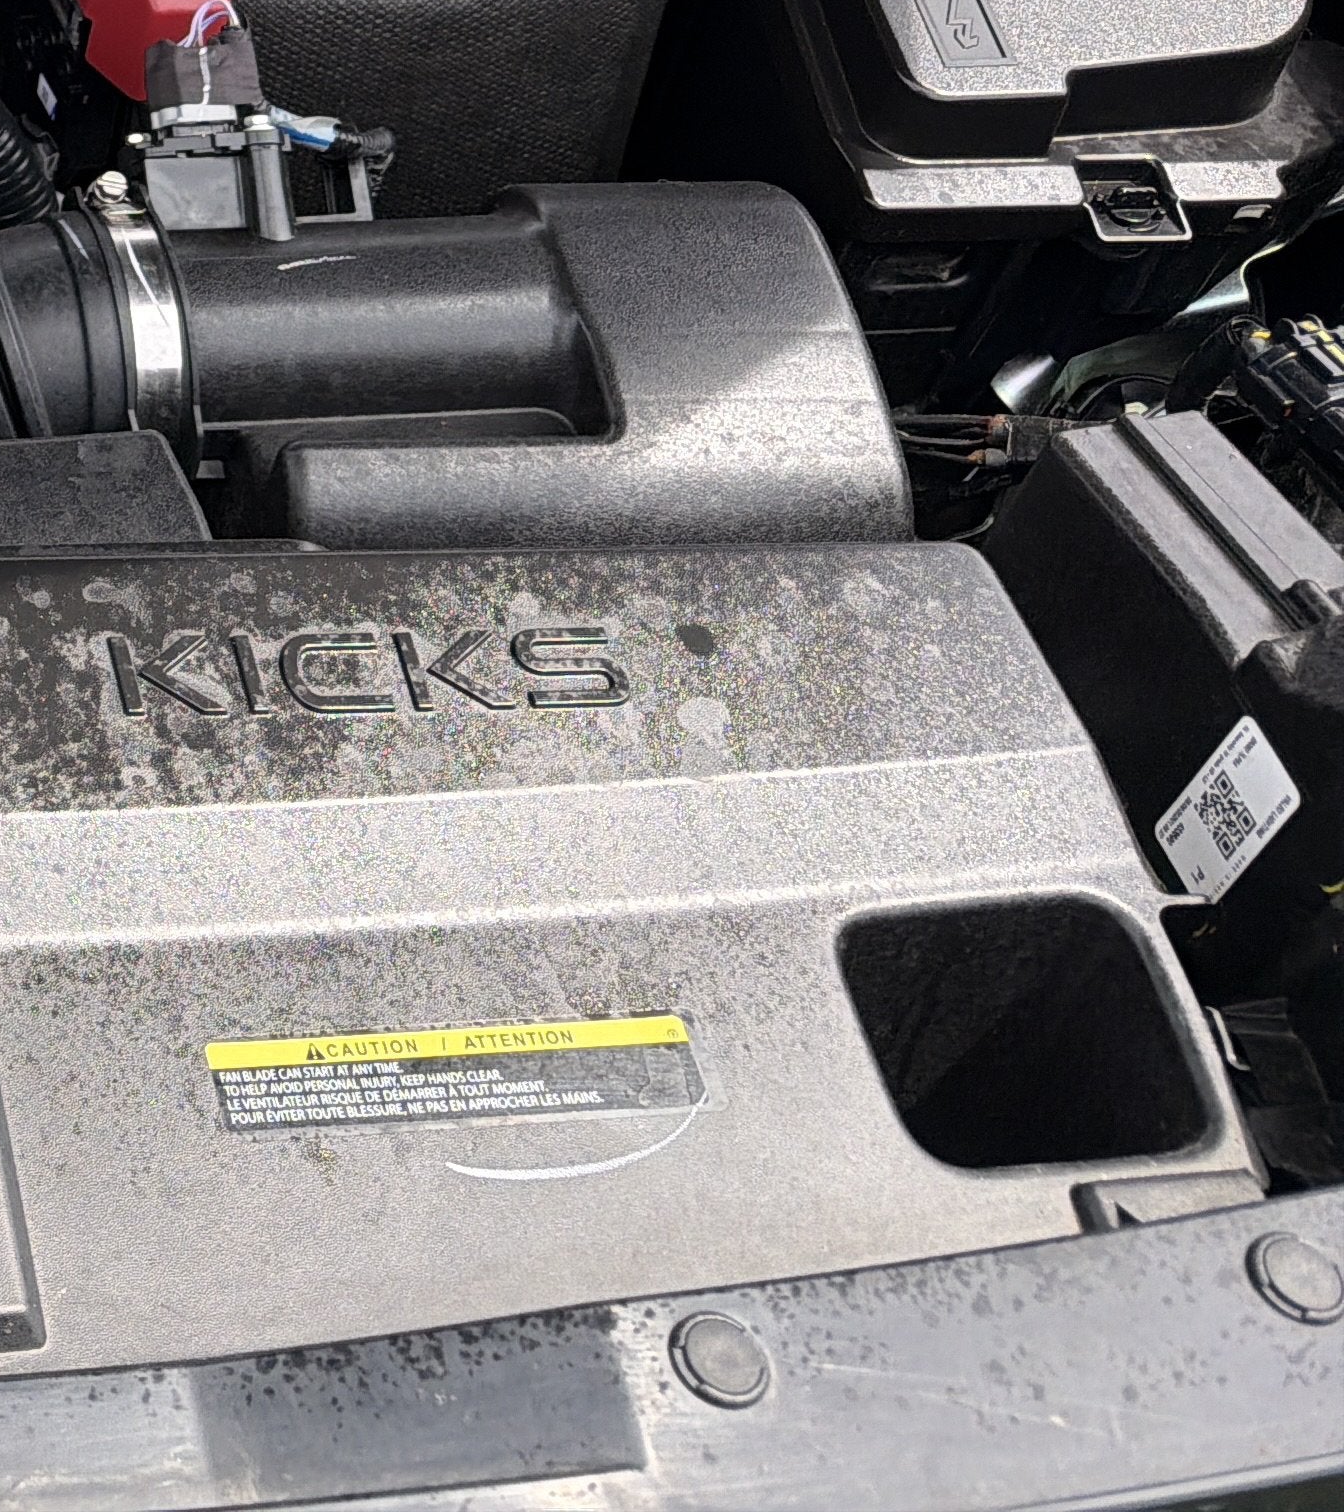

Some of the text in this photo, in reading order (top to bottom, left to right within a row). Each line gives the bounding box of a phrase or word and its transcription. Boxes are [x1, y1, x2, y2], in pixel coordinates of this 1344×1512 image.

[106, 627, 631, 718] KICKS
[1191, 865, 1205, 885] P1
[326, 1039, 418, 1057] CAUTION
[464, 1030, 574, 1050] ATTENTION
[219, 1061, 404, 1084] FAN BLADE CAN START AT ANY TIME.
[223, 1069, 504, 1097] TO HELP AVOID PERSONAL INJURY, KEEP HANDS CLEAR.
[227, 1080, 549, 1111] LE VENTILATEUR RISQUE DE DÉMARRER À TOUT MOMENT.
[230, 1090, 605, 1125] POUR ÉVITER TOUTE BLESSURE, NE PAS EN APPROCHER LES MAINS.
